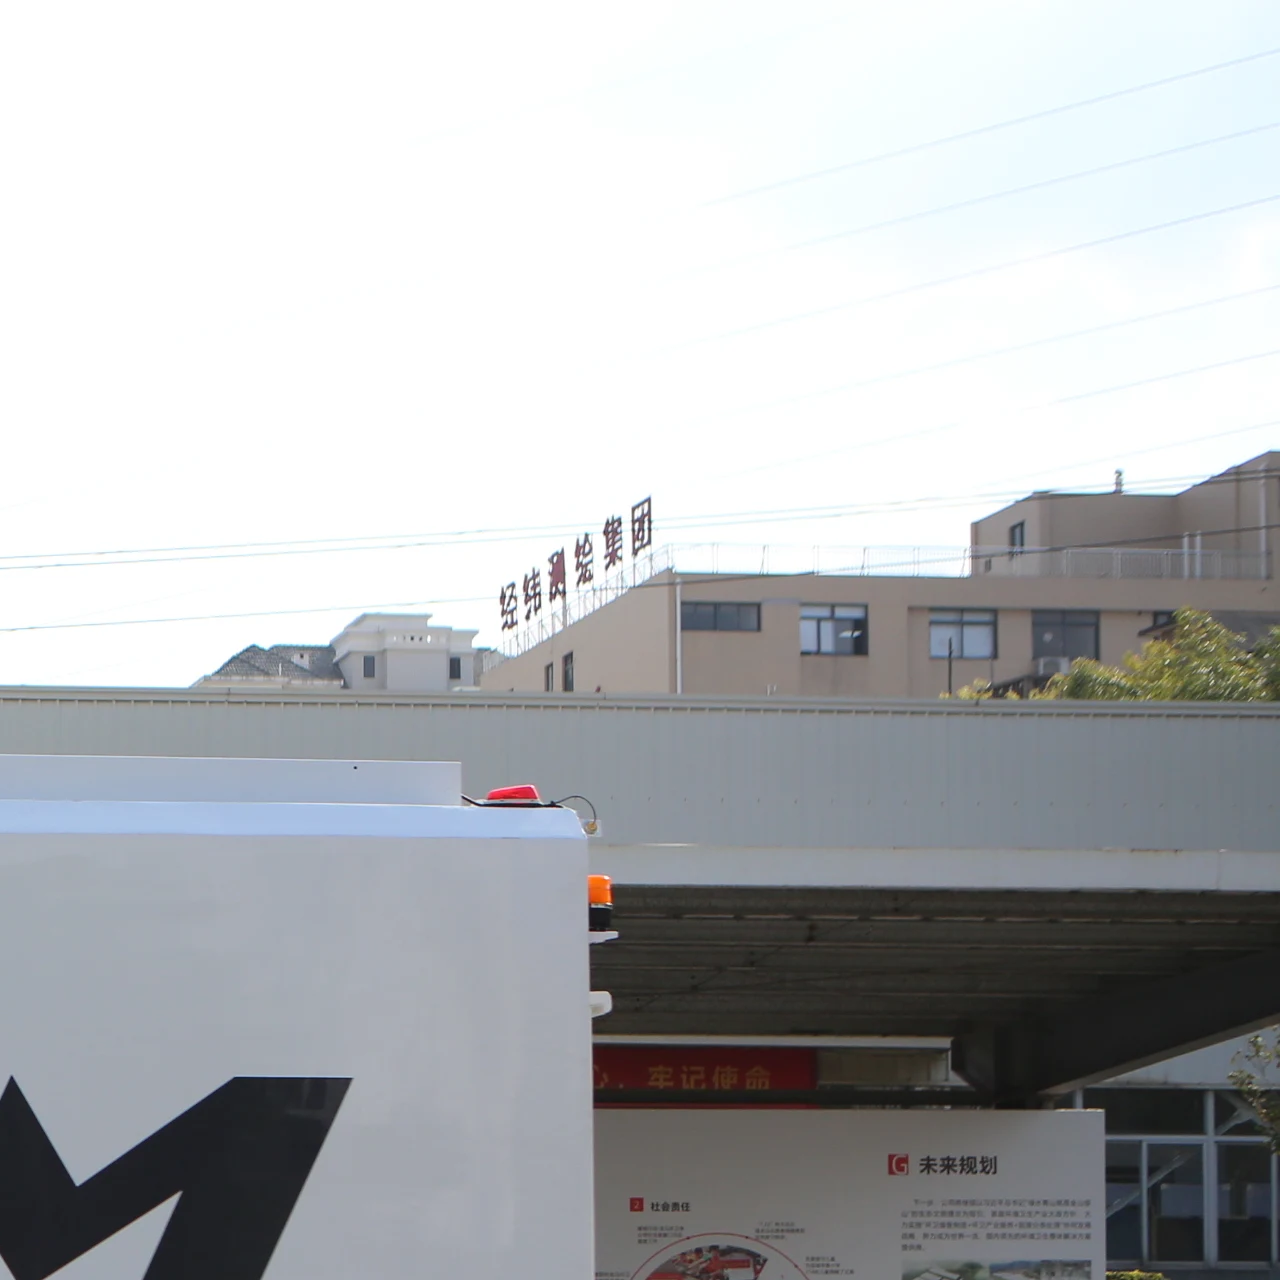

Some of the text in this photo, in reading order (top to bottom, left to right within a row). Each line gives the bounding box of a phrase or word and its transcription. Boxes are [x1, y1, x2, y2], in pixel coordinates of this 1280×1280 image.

[919, 1155, 998, 1175] 未来规划
[650, 1201, 690, 1212] 社会责任
